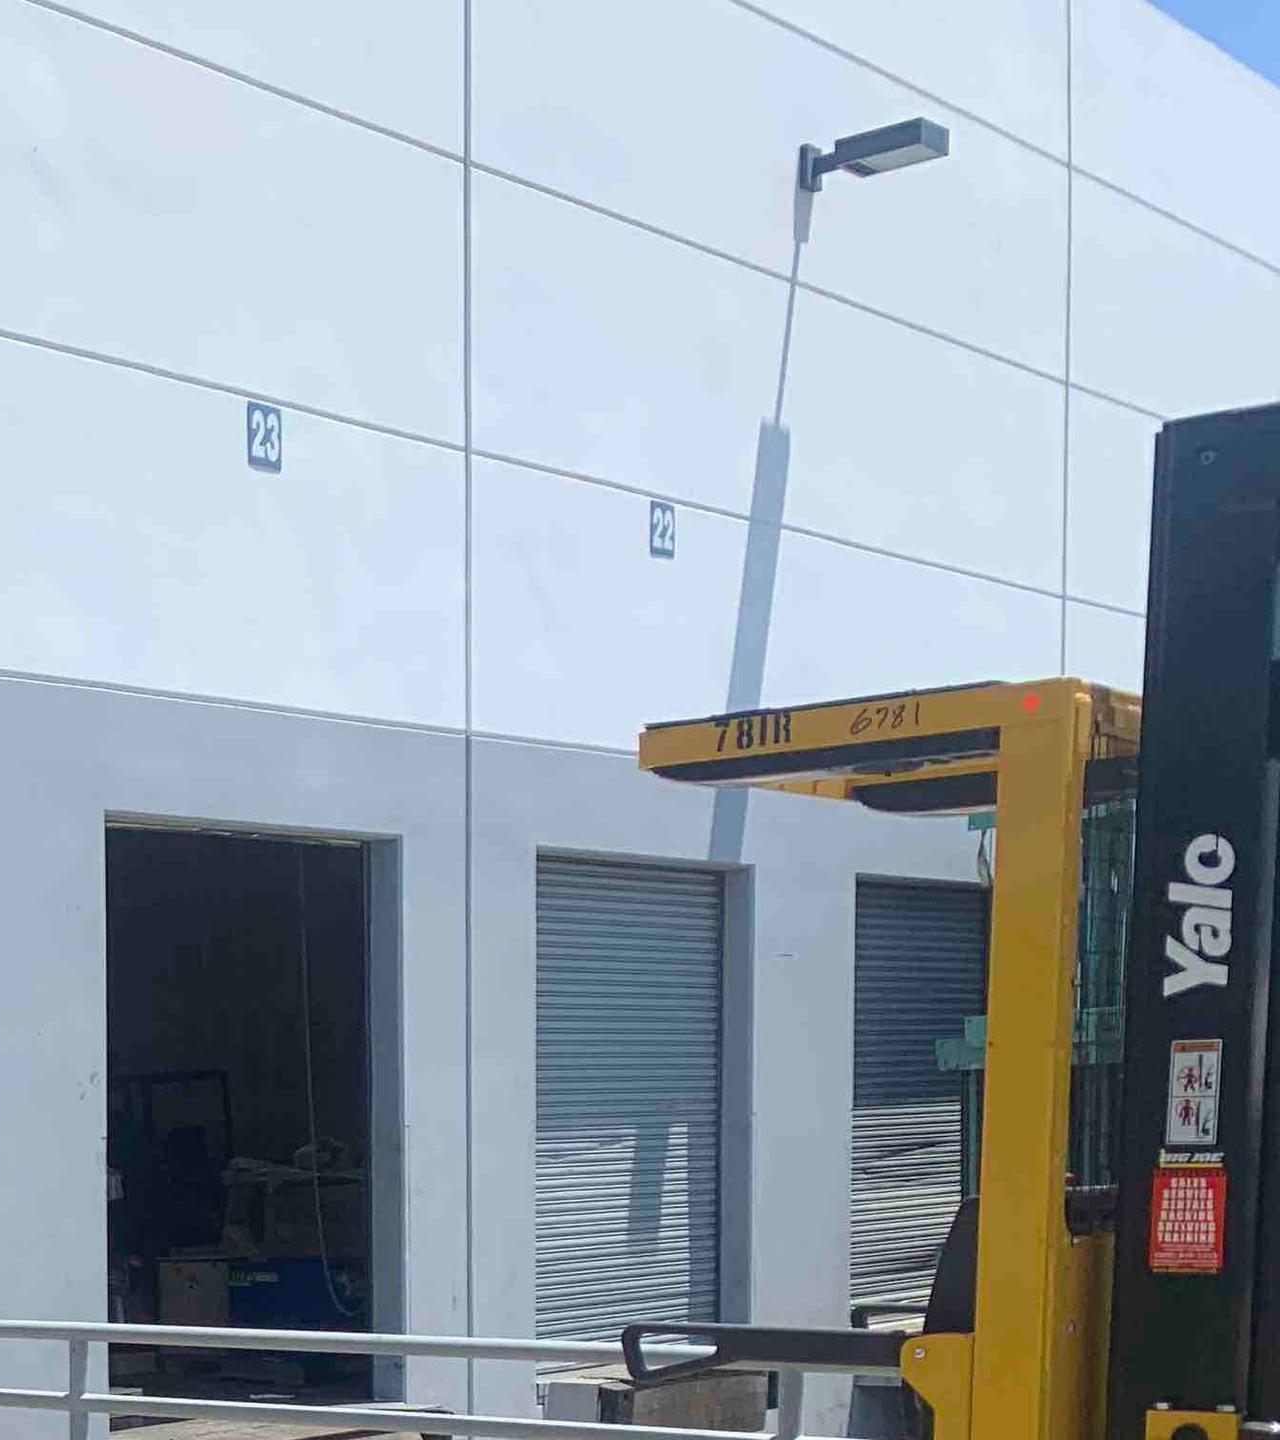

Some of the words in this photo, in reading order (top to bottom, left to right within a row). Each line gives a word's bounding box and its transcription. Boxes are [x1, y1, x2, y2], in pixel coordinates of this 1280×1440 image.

[252, 409, 280, 462] 23
[653, 507, 673, 550] 22
[849, 701, 919, 735] 6781
[1163, 833, 1236, 998] Yale
